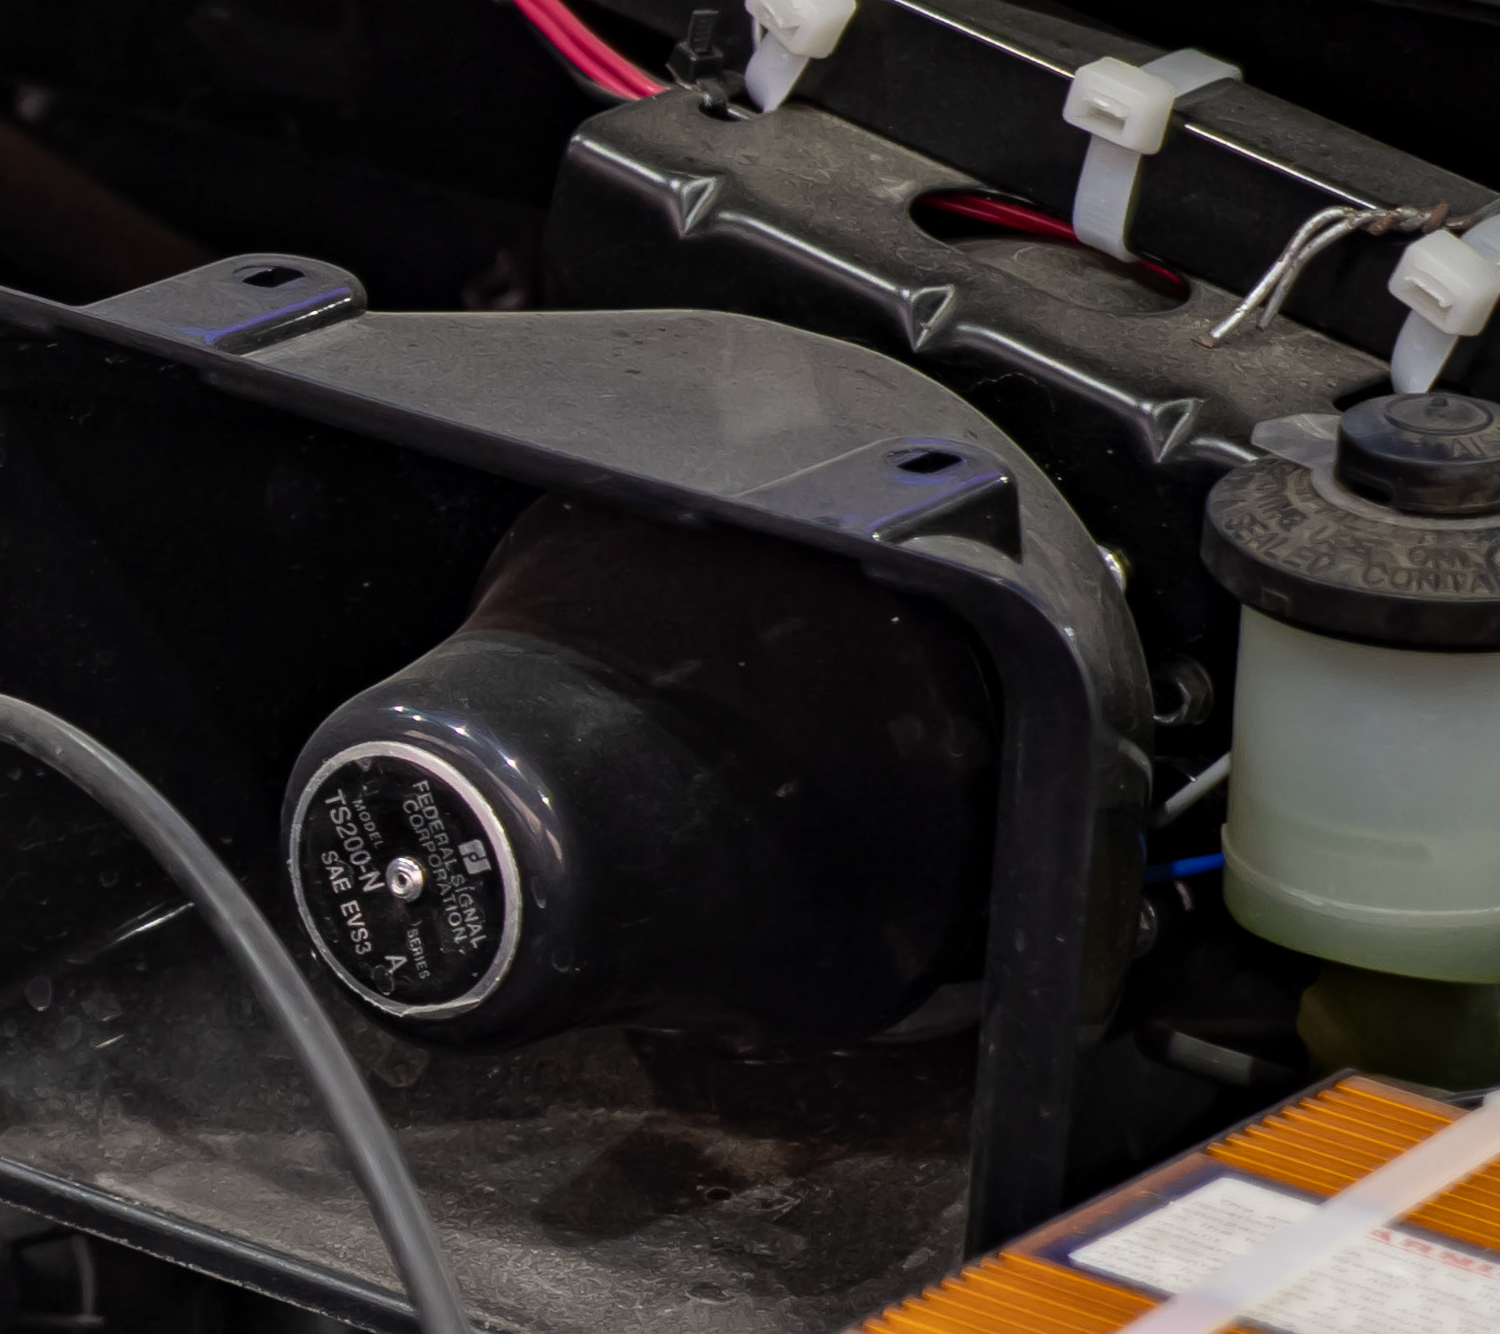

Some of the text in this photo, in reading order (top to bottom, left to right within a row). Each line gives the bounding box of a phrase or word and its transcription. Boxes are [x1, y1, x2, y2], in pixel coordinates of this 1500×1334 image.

[324, 788, 386, 893] TS200-N
[352, 797, 385, 849] MODEL
[402, 798, 468, 945] CORPORATION
[412, 779, 487, 949] FEDERAL SIGNAL
[321, 850, 373, 956] SAE EVS3
[406, 928, 431, 980] SERIES
[385, 955, 408, 974] A
